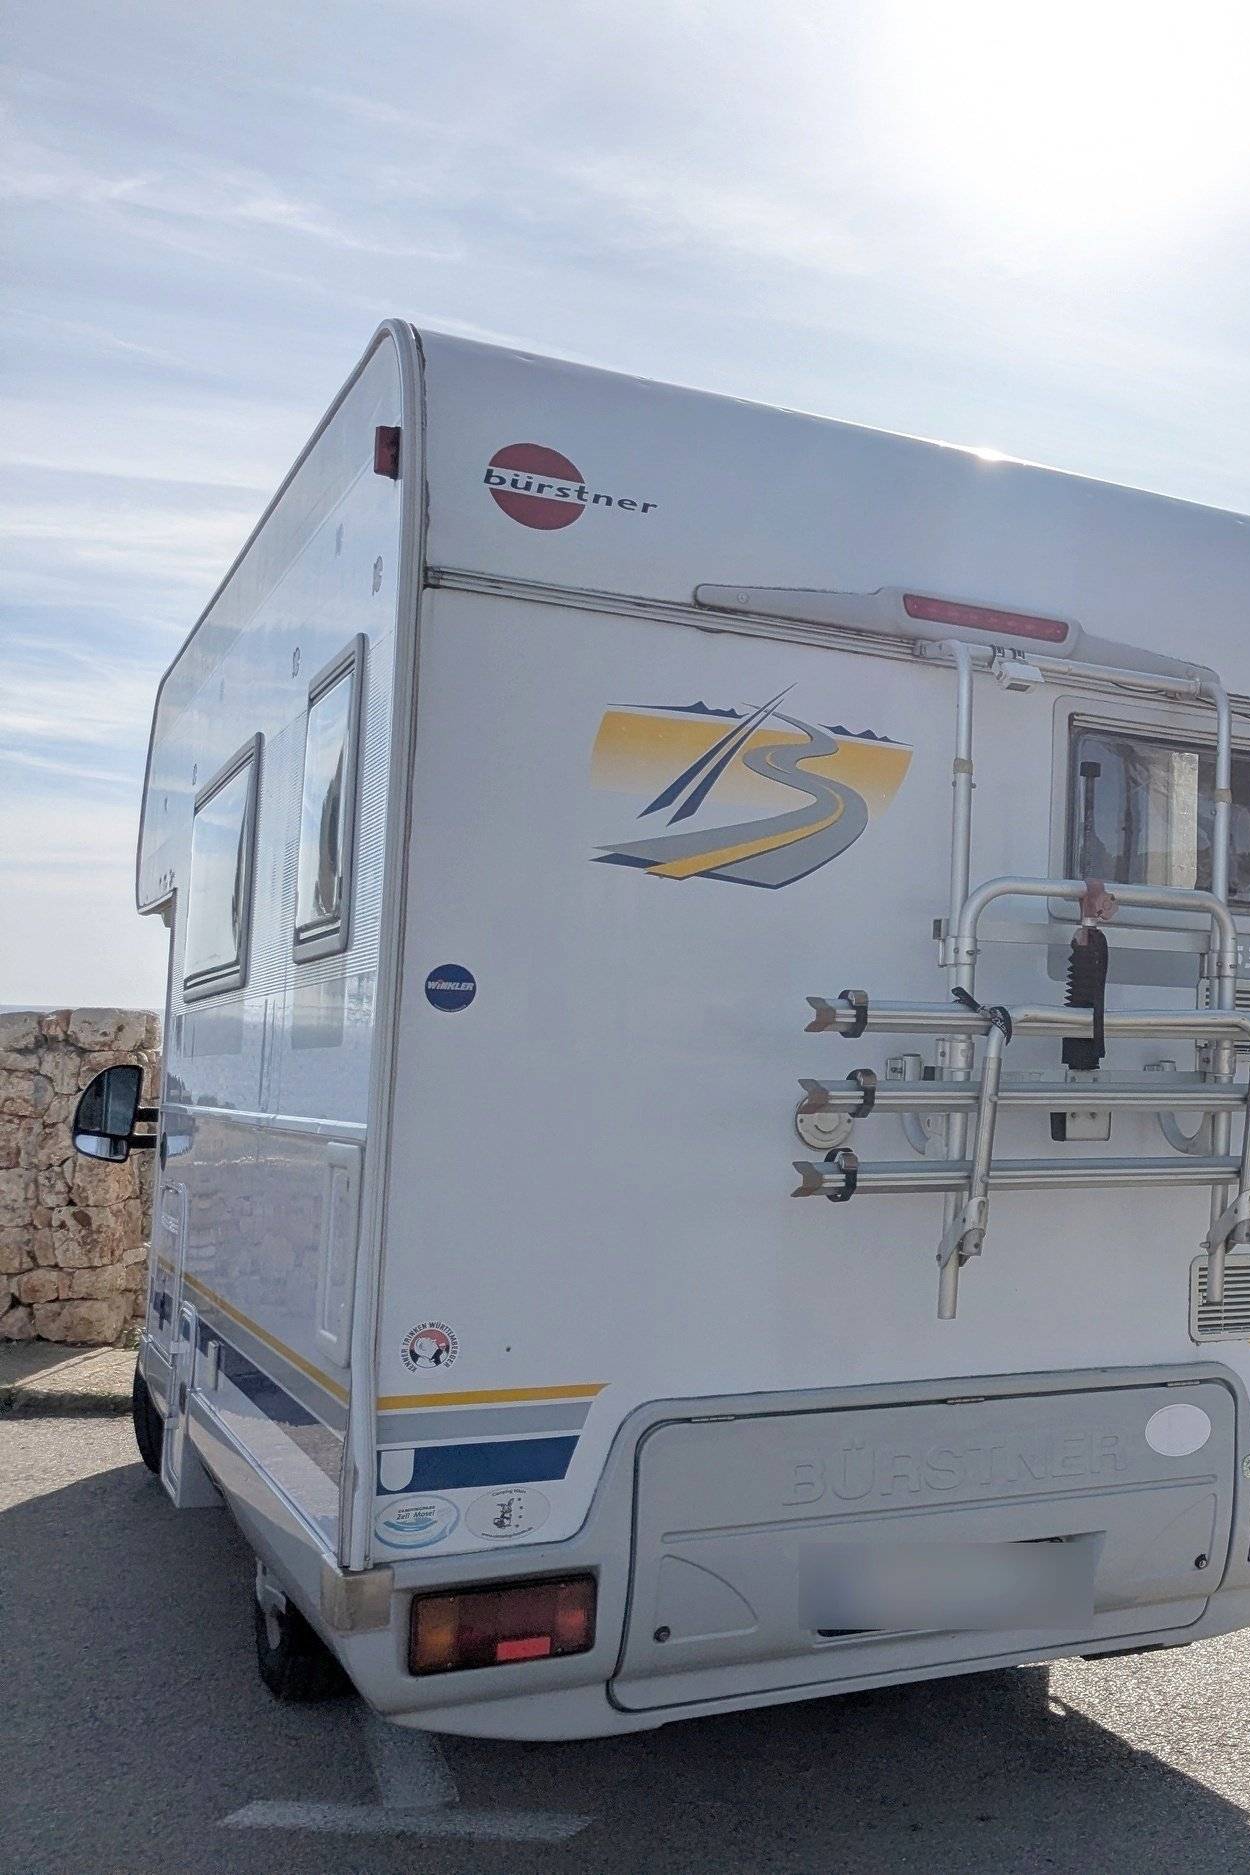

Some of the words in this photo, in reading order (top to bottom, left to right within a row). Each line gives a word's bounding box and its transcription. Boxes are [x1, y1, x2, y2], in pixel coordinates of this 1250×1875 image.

[483, 468, 658, 514] bürstner
[402, 1322, 428, 1346] TRINKEN
[782, 1434, 1127, 1506] BÜRSTNER
[396, 1512, 410, 1520] Zell
[413, 1509, 436, 1518] Mosel
